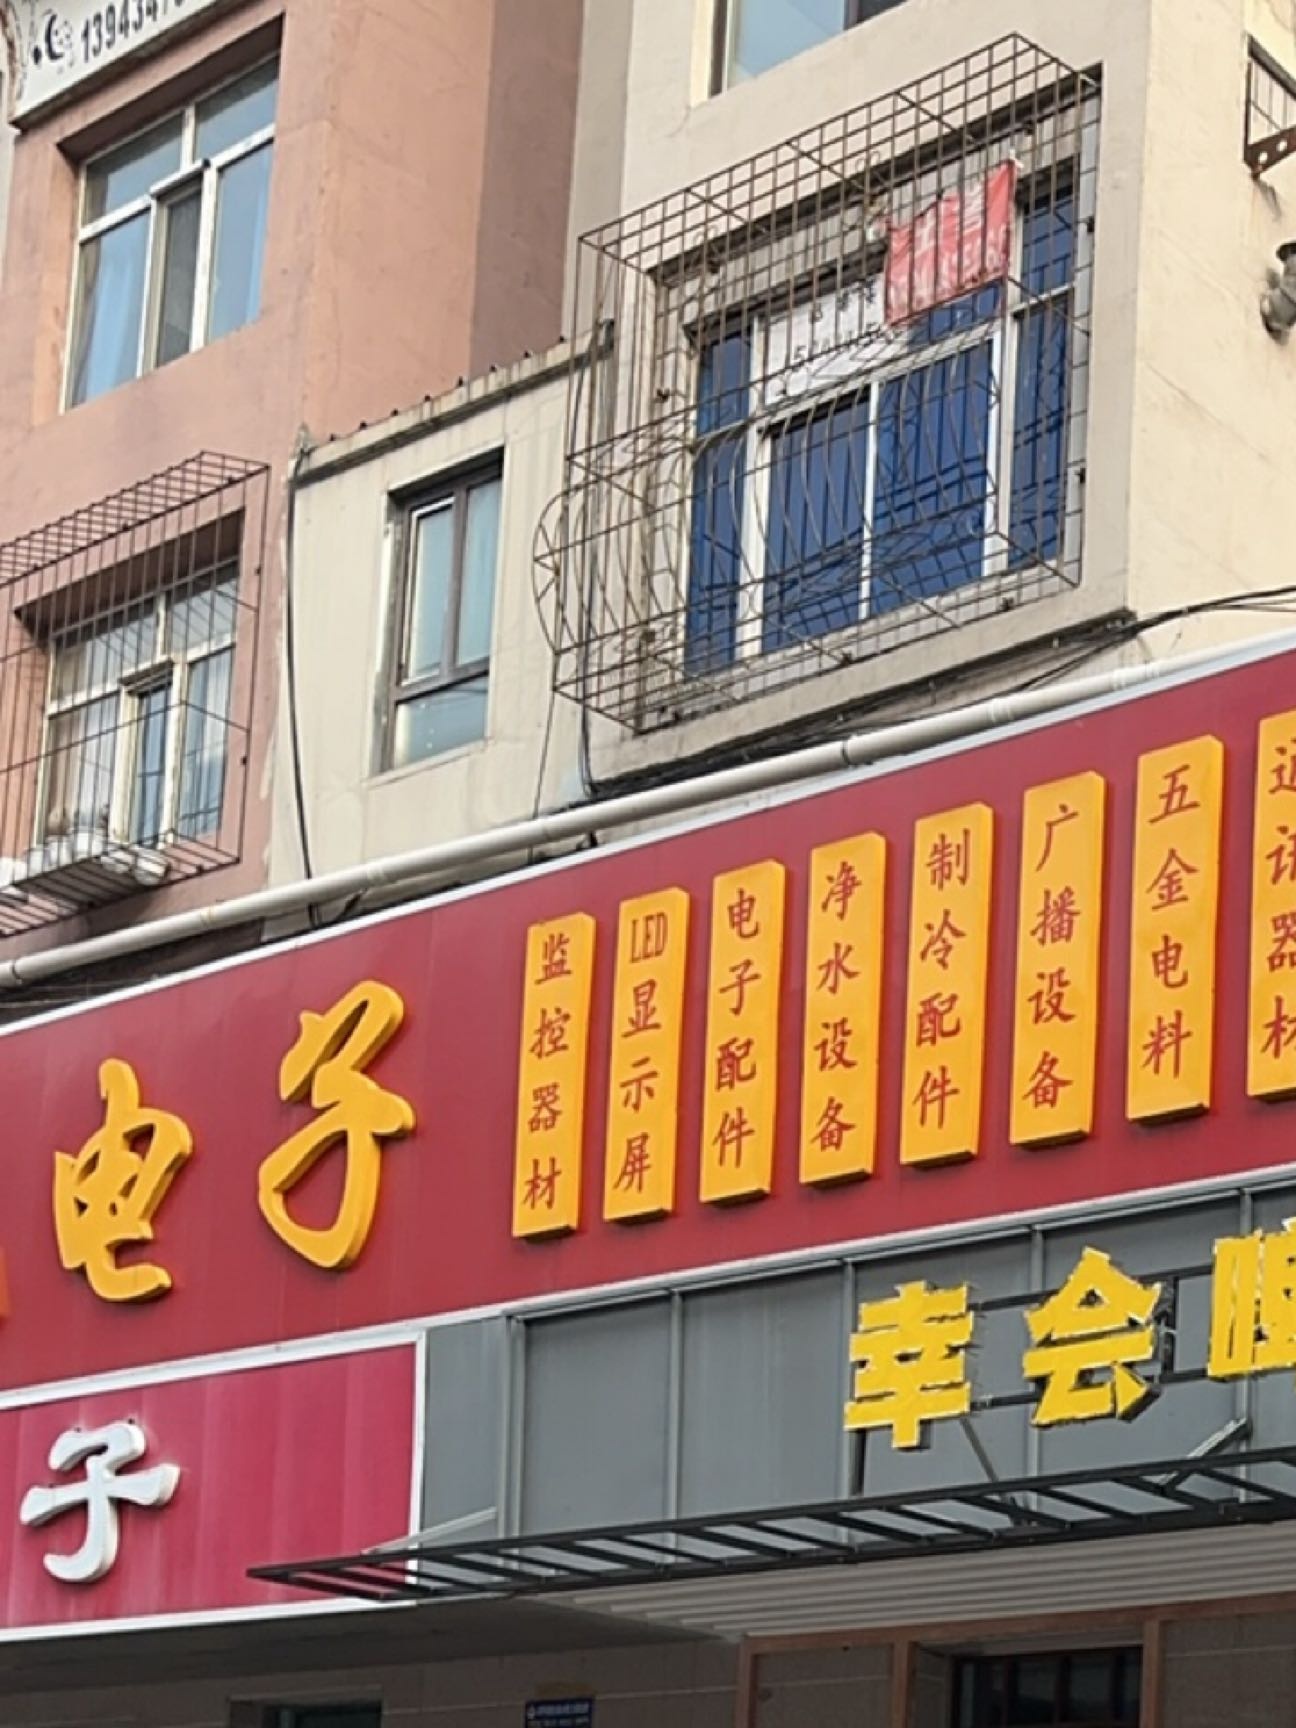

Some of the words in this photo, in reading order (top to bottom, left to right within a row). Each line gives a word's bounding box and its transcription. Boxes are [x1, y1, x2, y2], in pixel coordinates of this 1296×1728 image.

[82, 0, 183, 63] 139434
[613, 912, 669, 1192] LED显示屏
[712, 888, 761, 1168] 电子配件
[811, 861, 862, 1152] 净水设备
[912, 828, 971, 1129] 制冷配件
[1021, 804, 1080, 1109] 广播设备
[1142, 764, 1201, 1079] 五金电料
[0, 981, 416, 1320] 电子
[523, 933, 573, 1211] 监控器材
[20, 1420, 181, 1583] 子
